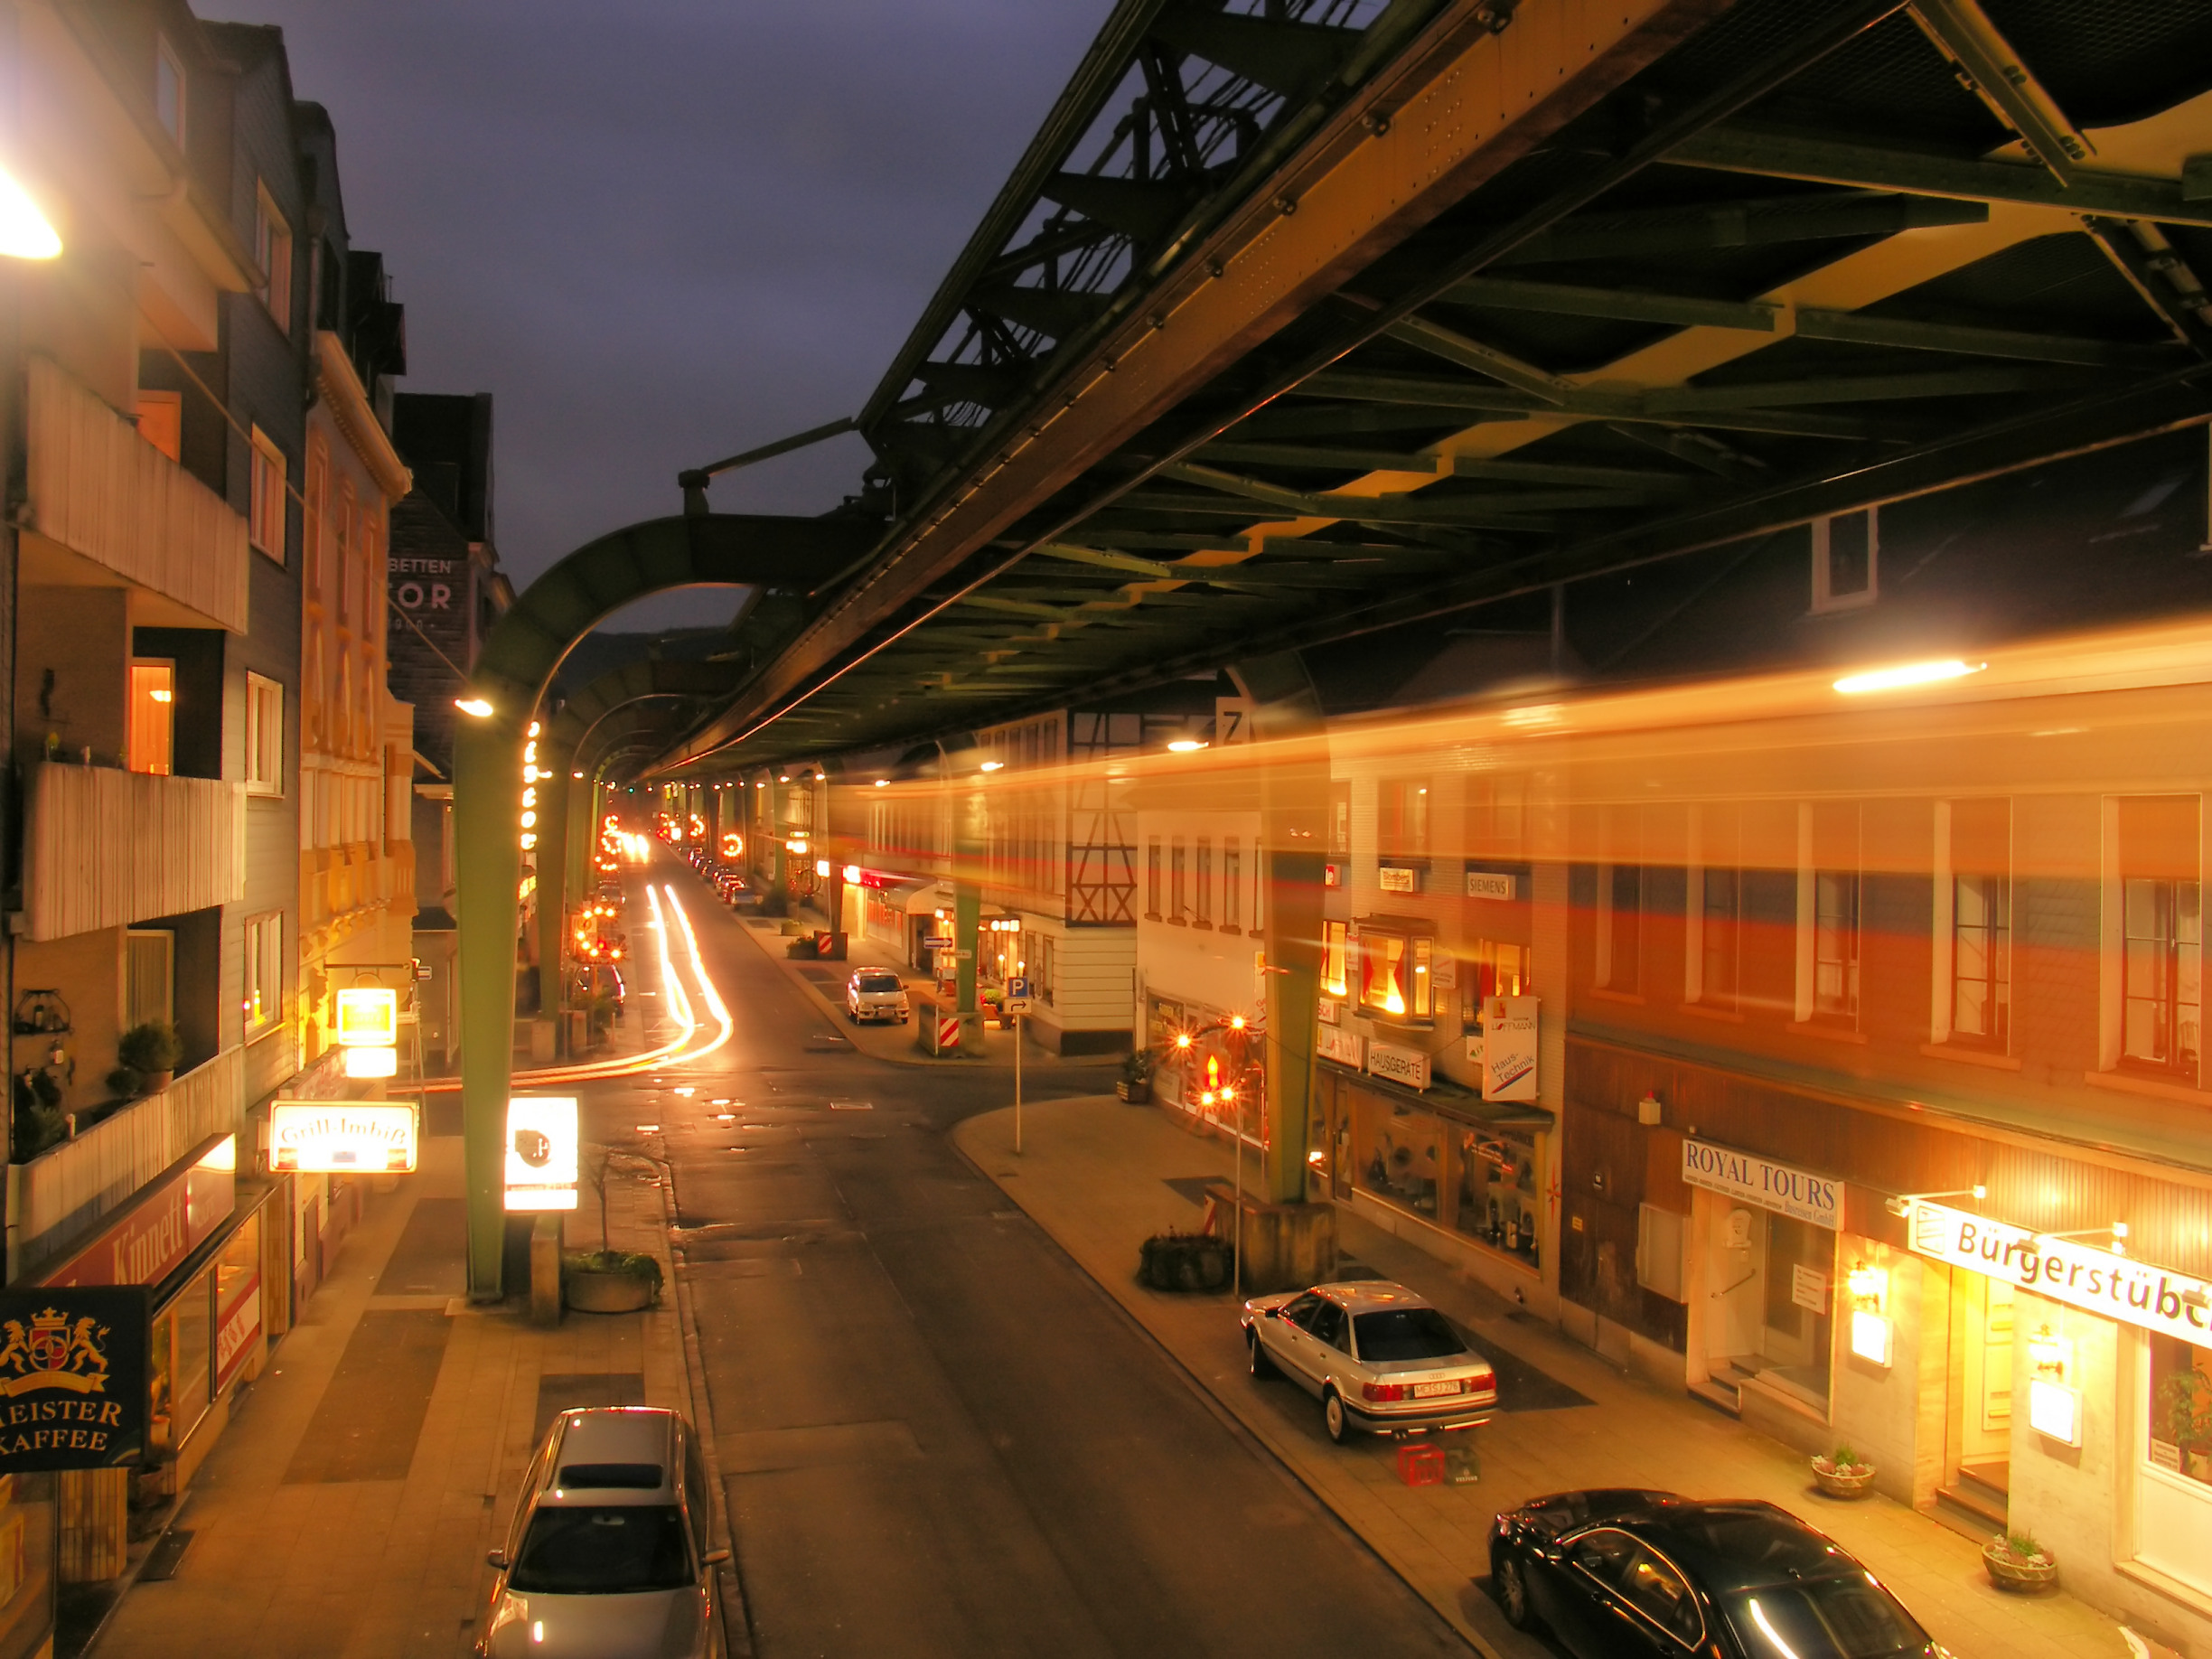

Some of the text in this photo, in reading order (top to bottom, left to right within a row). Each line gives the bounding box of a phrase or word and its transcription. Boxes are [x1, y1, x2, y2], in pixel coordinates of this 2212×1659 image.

[389, 558, 451, 574] BETTEN
[388, 582, 451, 610] OR
[1469, 878, 1506, 895] SIEMENS
[1012, 979, 1024, 995] P
[1491, 1053, 1518, 1073] Haus-
[1496, 1055, 1534, 1083] Technik
[1686, 1143, 1753, 1186] ROYAL
[1760, 1165, 1834, 1211] TOURS
[113, 1190, 183, 1285] Kinnett
[1958, 1223, 2212, 1332] Bürgerstübc
